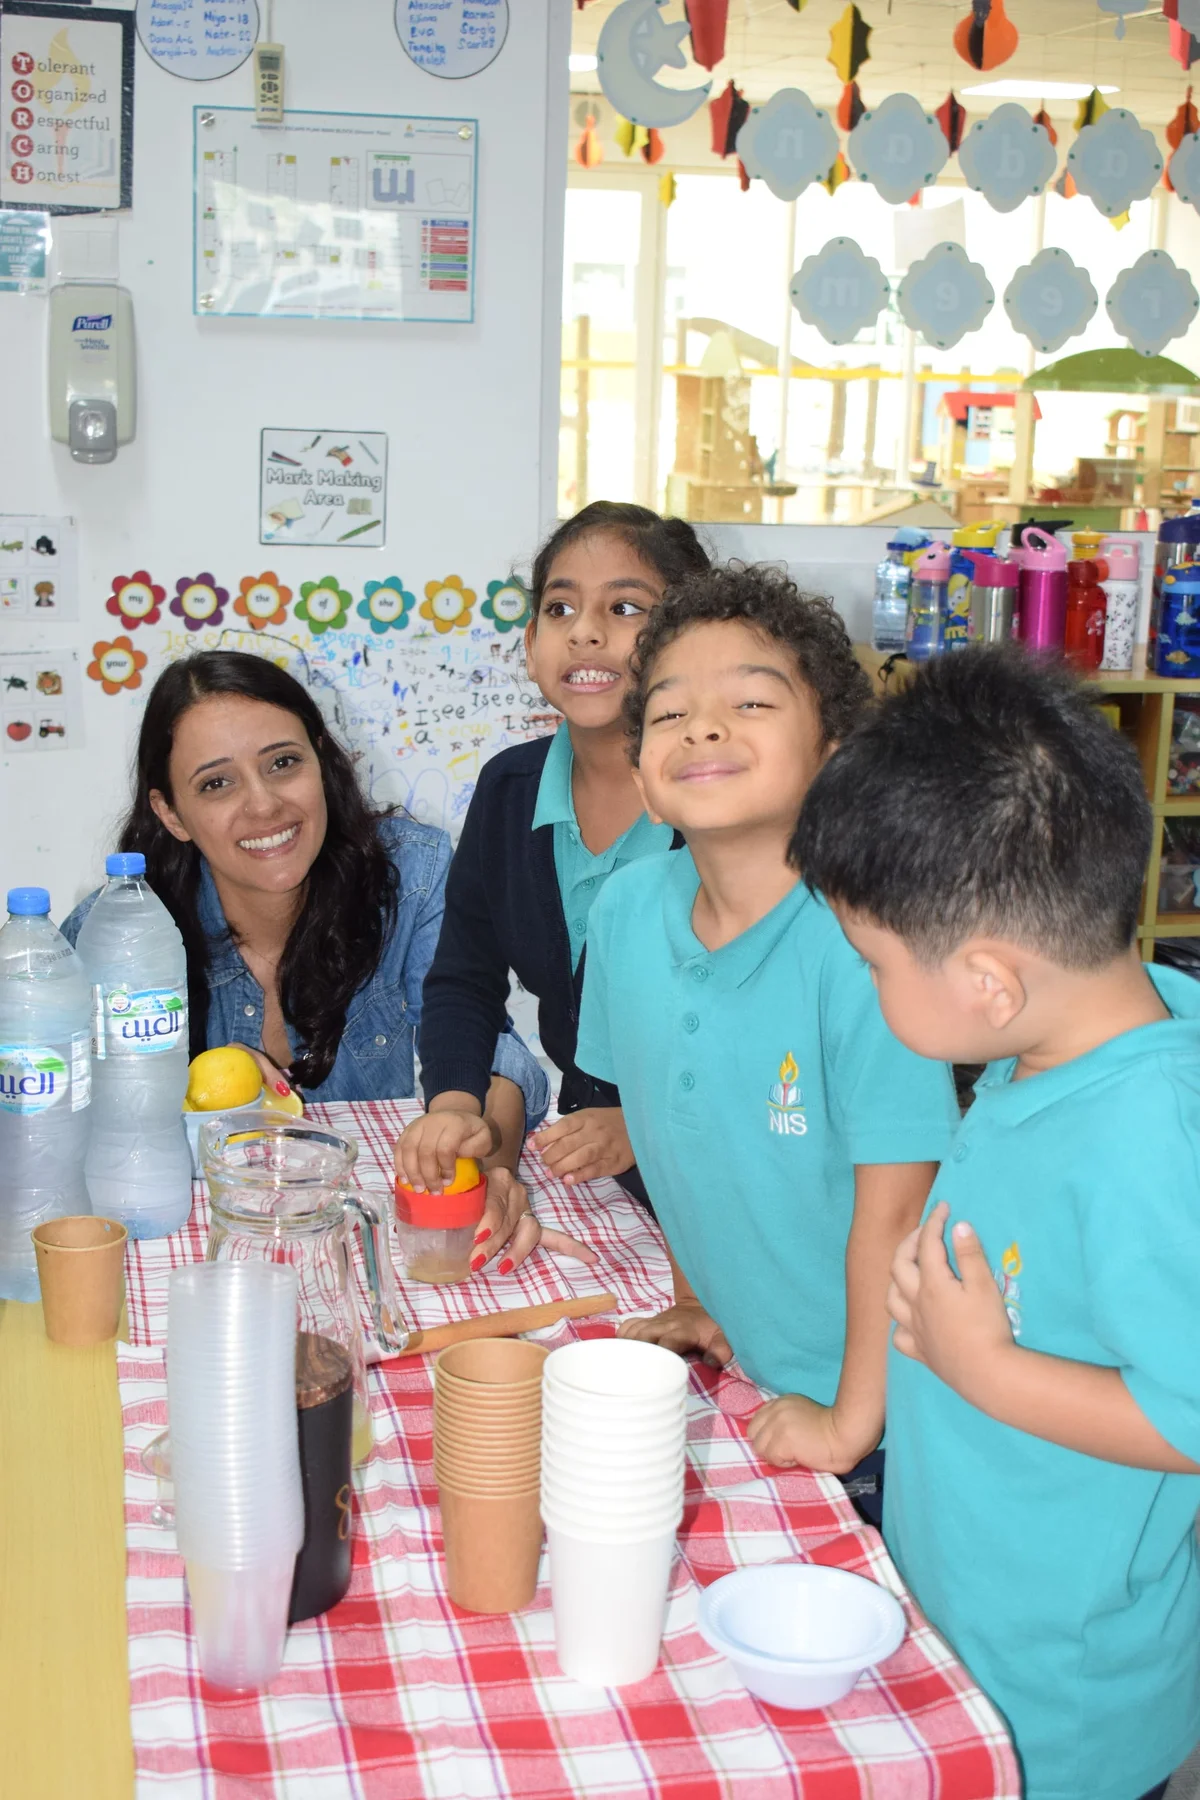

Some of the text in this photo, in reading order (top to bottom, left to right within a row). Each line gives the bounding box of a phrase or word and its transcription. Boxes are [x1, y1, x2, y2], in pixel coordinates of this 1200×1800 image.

[16, 56, 96, 76] Tolerant
[16, 80, 107, 104] Organized
[16, 111, 110, 132] Respectful
[16, 139, 80, 159] Caring
[16, 166, 81, 183] Honest
[75, 317, 111, 331] Purell
[266, 467, 382, 493] Mark Making
[303, 488, 345, 506] Area
[128, 595, 144, 605] my
[105, 659, 128, 669] your
[122, 1011, 179, 1042] العين
[0, 1071, 55, 1099] العي
[769, 1109, 808, 1136] NIS
